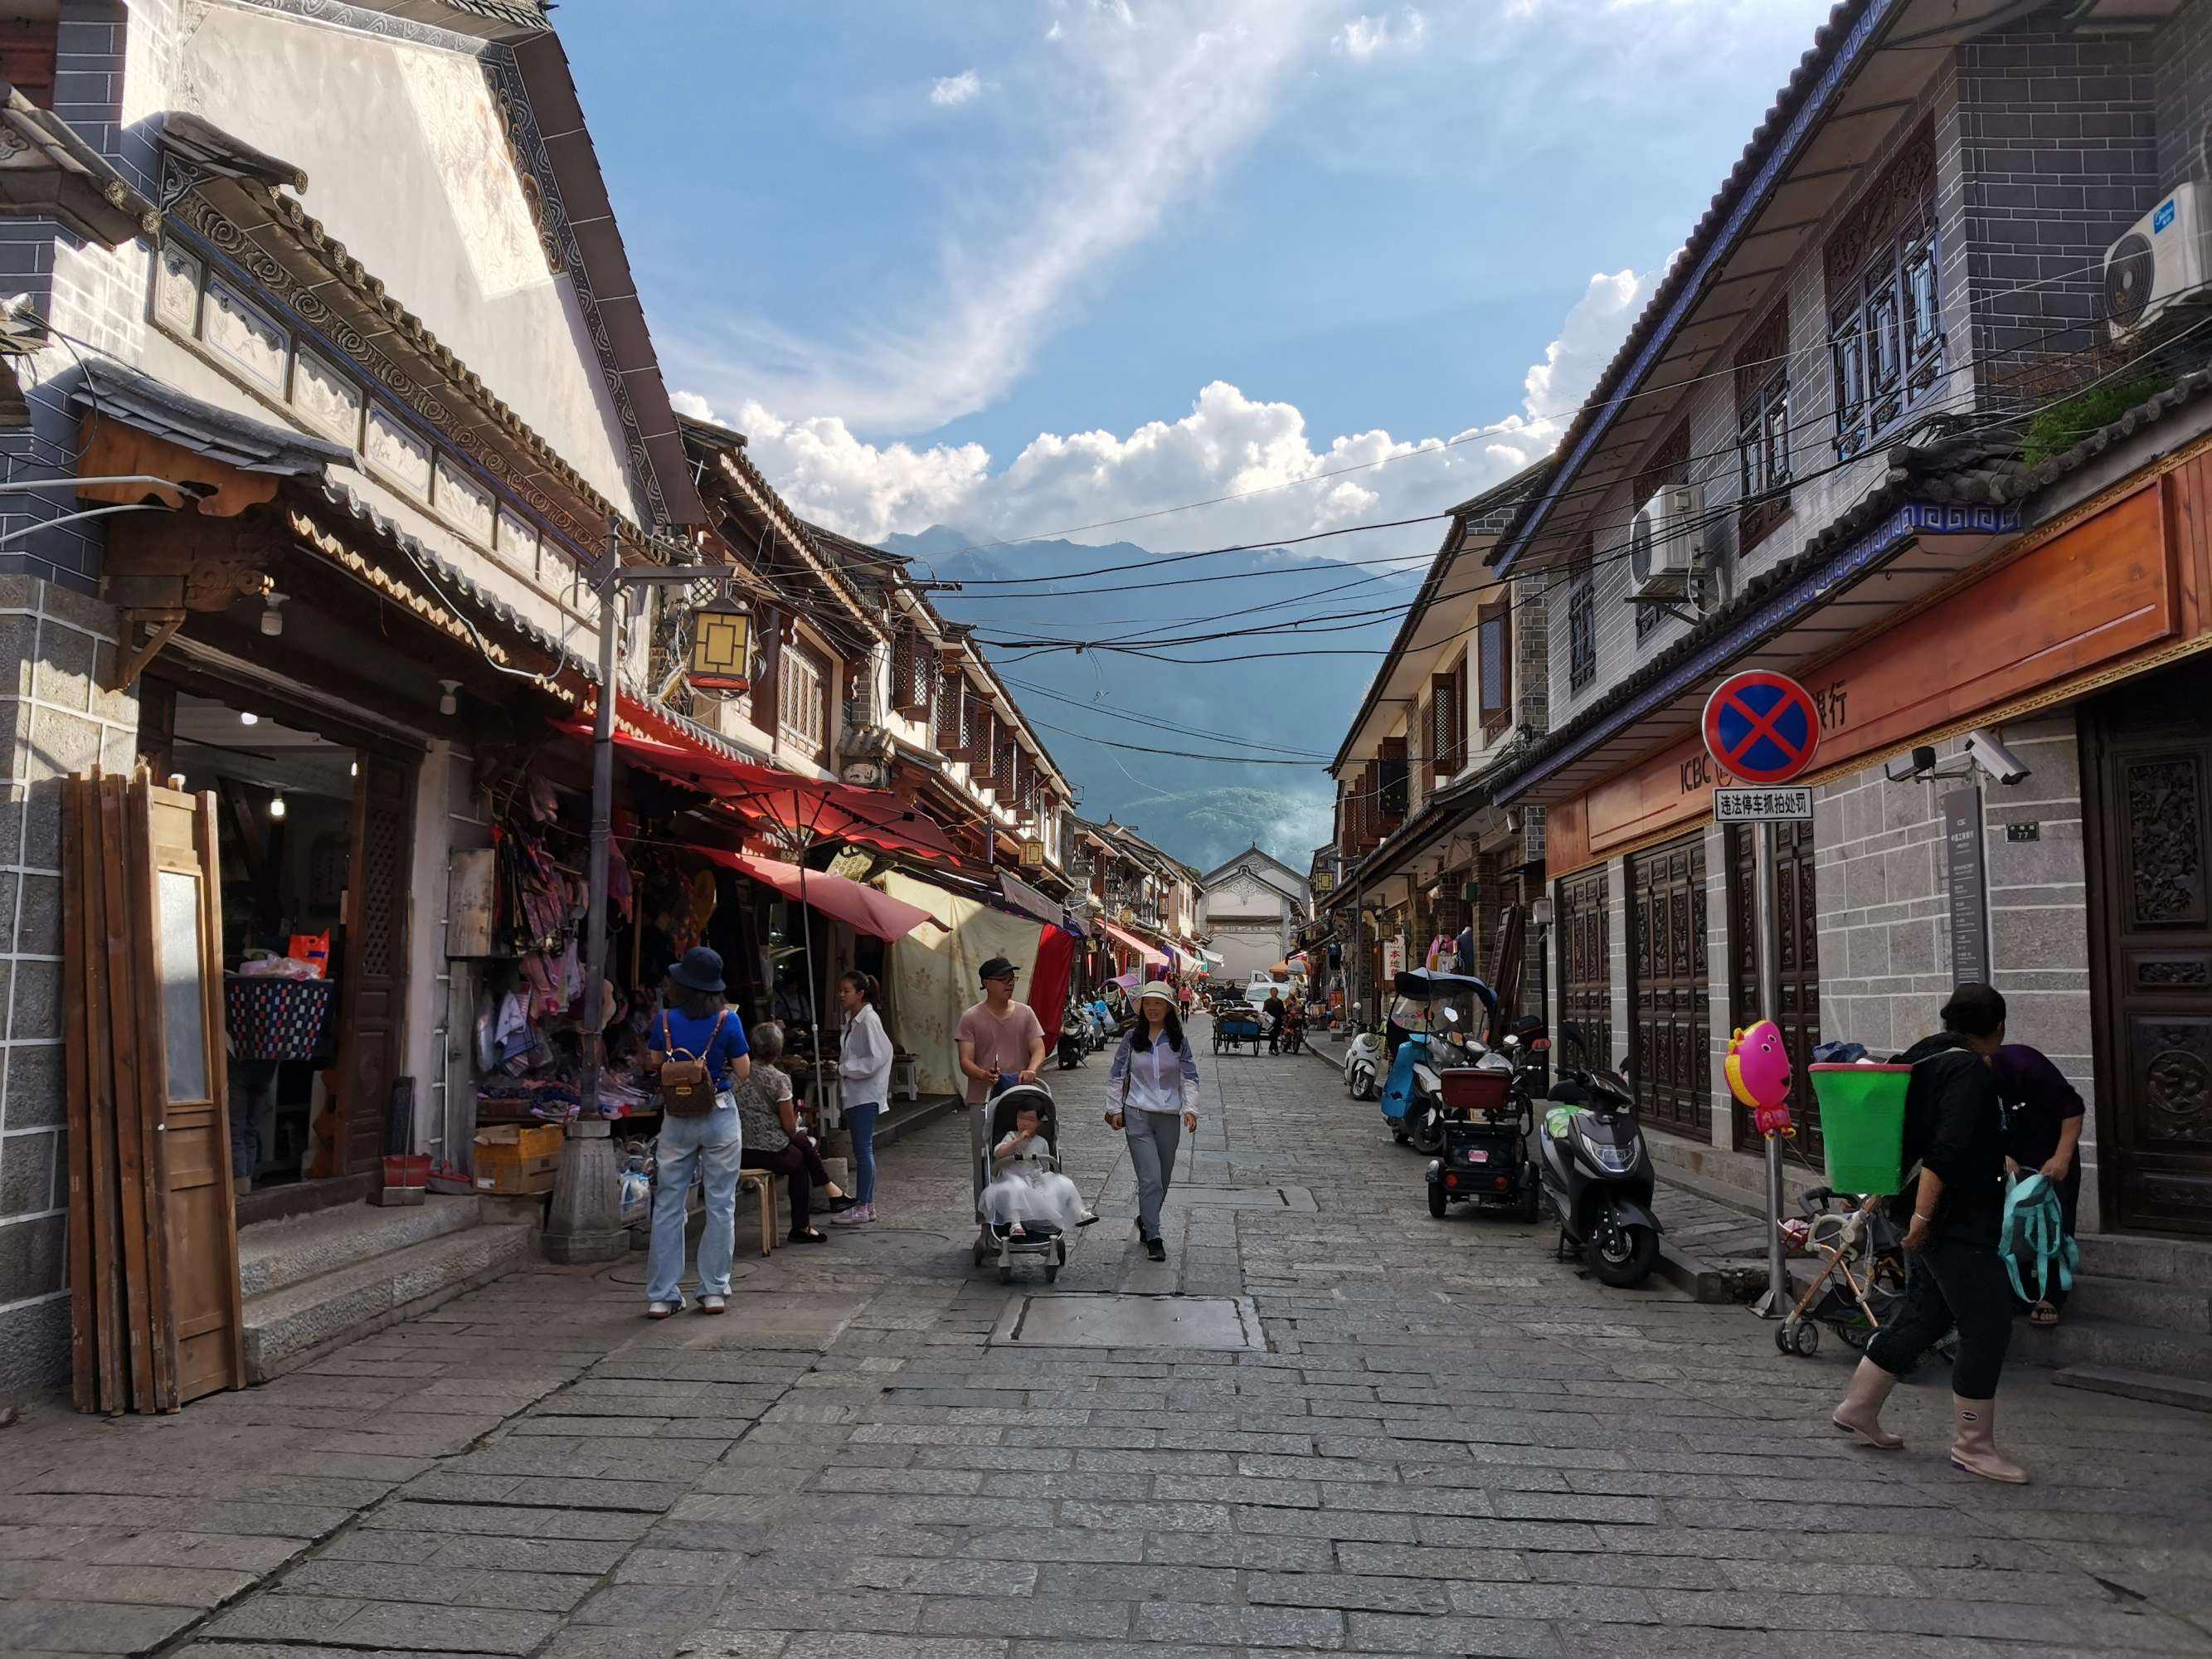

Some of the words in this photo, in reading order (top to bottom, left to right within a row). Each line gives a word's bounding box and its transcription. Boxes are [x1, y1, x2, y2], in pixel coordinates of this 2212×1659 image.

[1680, 752, 1712, 795] ICBC
[1721, 793, 1806, 815] 违法停车抓拍处罚
